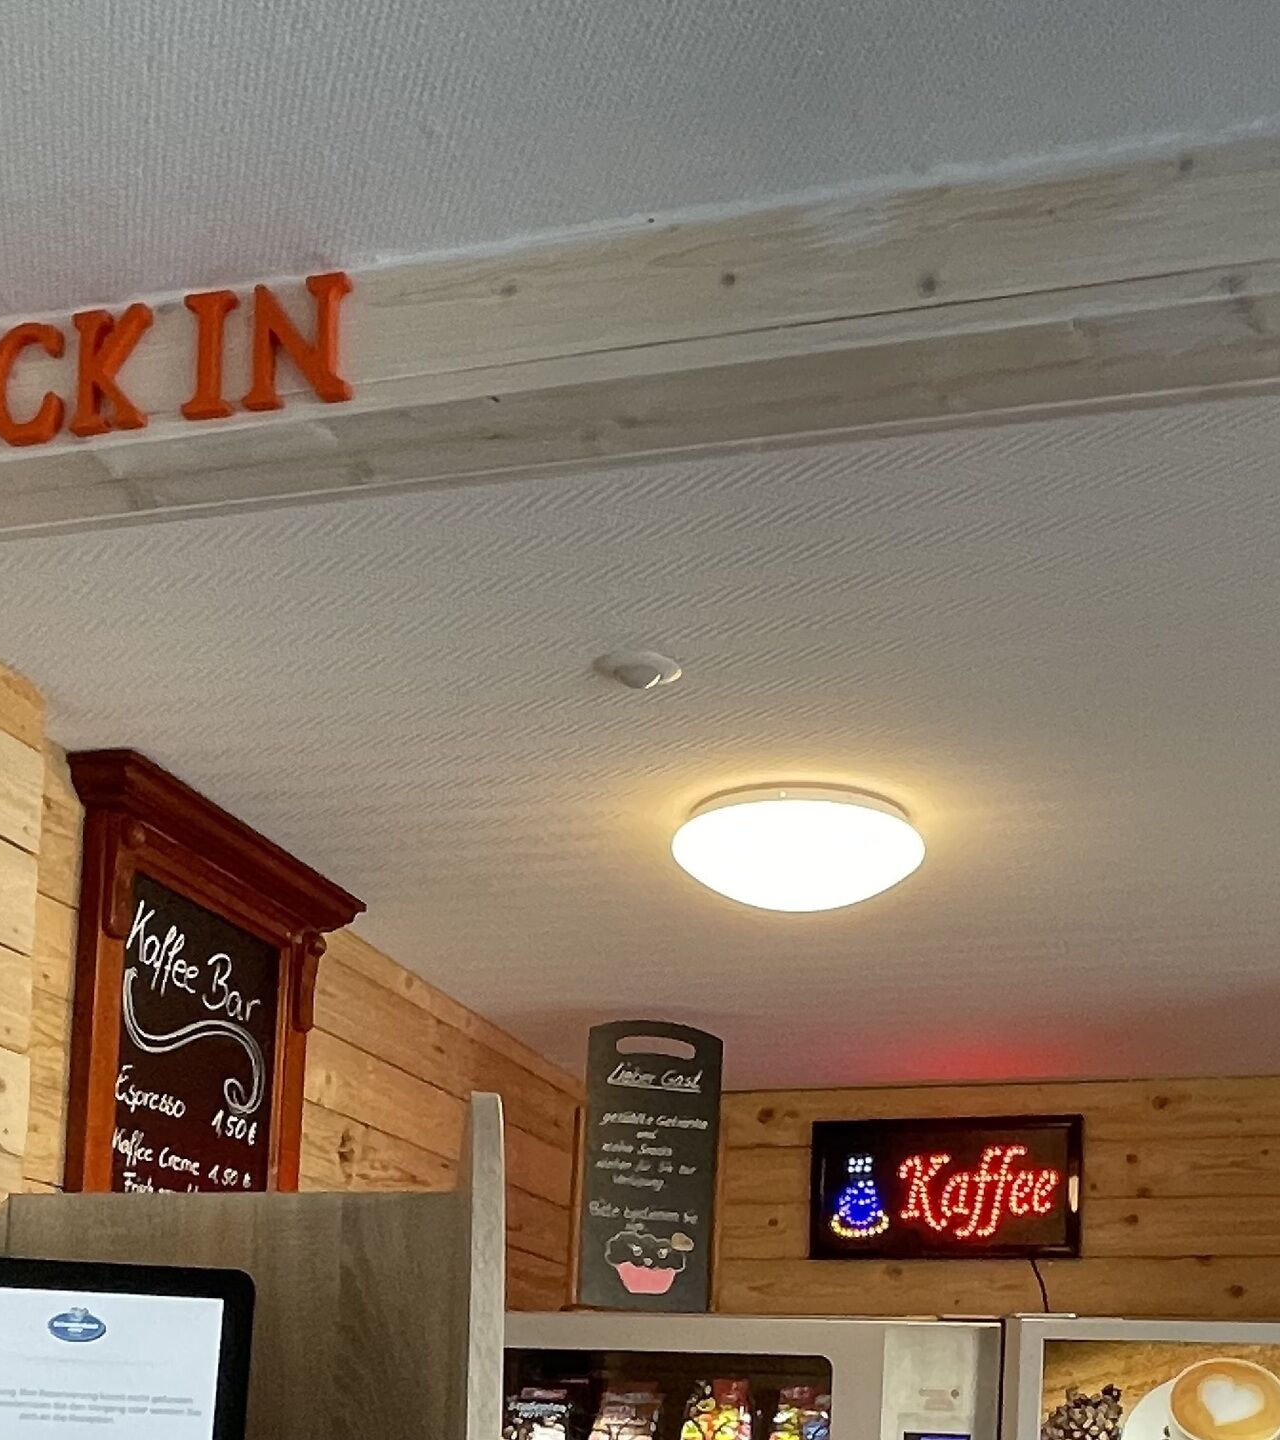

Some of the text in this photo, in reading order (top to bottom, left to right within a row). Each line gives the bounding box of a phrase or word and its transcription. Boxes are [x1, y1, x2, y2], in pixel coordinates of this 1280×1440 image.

[180, 271, 354, 421] IN
[125, 899, 261, 1021] Kaffee Bar
[114, 1064, 186, 1118] Espresso
[897, 1145, 1060, 1238] Kaffee
